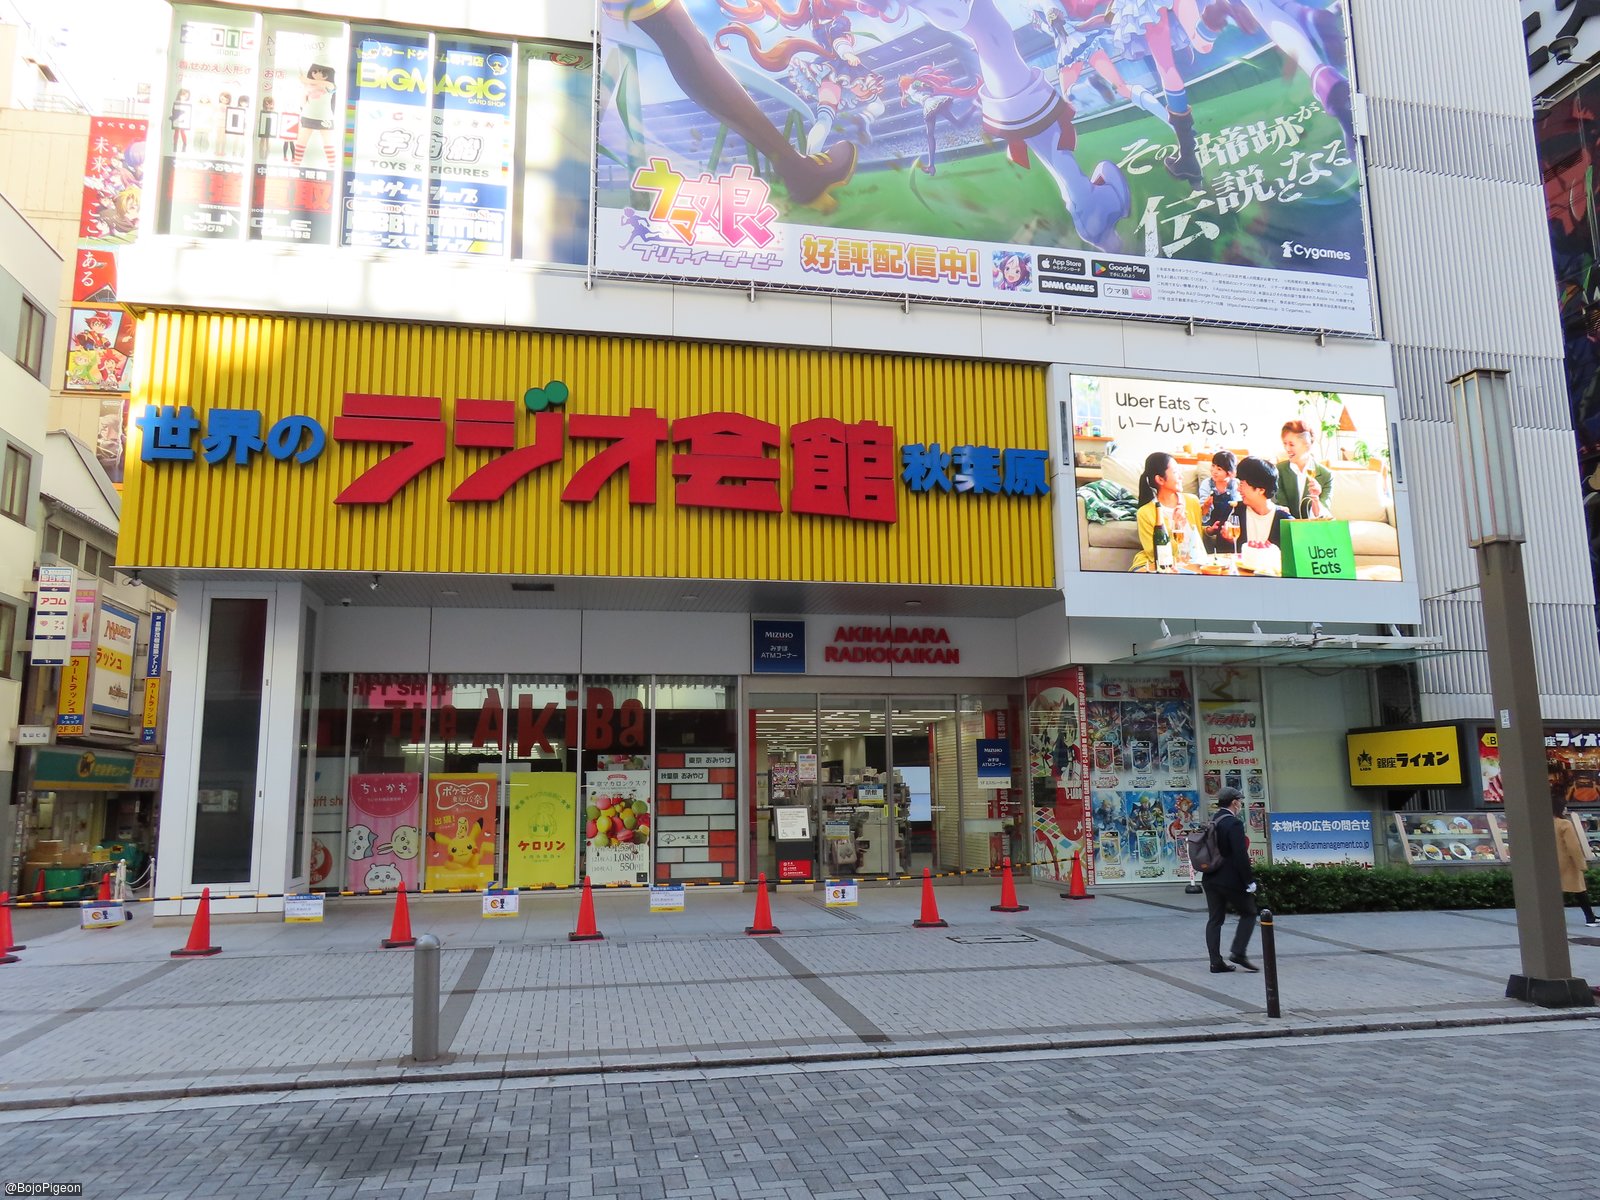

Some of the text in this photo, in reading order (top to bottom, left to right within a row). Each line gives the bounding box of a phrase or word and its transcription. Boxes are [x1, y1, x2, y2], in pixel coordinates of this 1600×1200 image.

[369, 159, 407, 172] TOYS
[430, 165, 490, 179] FIGURES
[631, 242, 784, 271] プリティーダービー
[1293, 244, 1351, 261] Cygames
[1052, 258, 1082, 268] App Store
[1108, 263, 1132, 274] Google
[1132, 265, 1147, 275] Play
[1041, 280, 1095, 293] DMM GAMES
[1106, 286, 1129, 296] ウマ娘
[1115, 392, 1155, 409] Uber
[1158, 395, 1191, 411] Eats
[136, 380, 1051, 523] 世界の ラジオ会館 秋葉原
[1307, 545, 1339, 560] Uber
[1311, 561, 1342, 576] Eats
[40, 597, 68, 606] アコム
[765, 631, 794, 639] MIZUHO
[833, 626, 950, 644] AKIHABARA
[824, 646, 960, 664] RADIOKAIKAN
[67, 658, 80, 714] カートラッシュ
[58, 725, 81, 733] 2F 3F
[1212, 734, 1236, 745] 700
[1544, 732, 1600, 747] 座ライオ
[1376, 751, 1450, 769] 銀座ライオン
[360, 782, 408, 794] ちいかわ
[1271, 820, 1370, 833] 本物件の広告の問合せ
[518, 840, 565, 851] ケロリン
